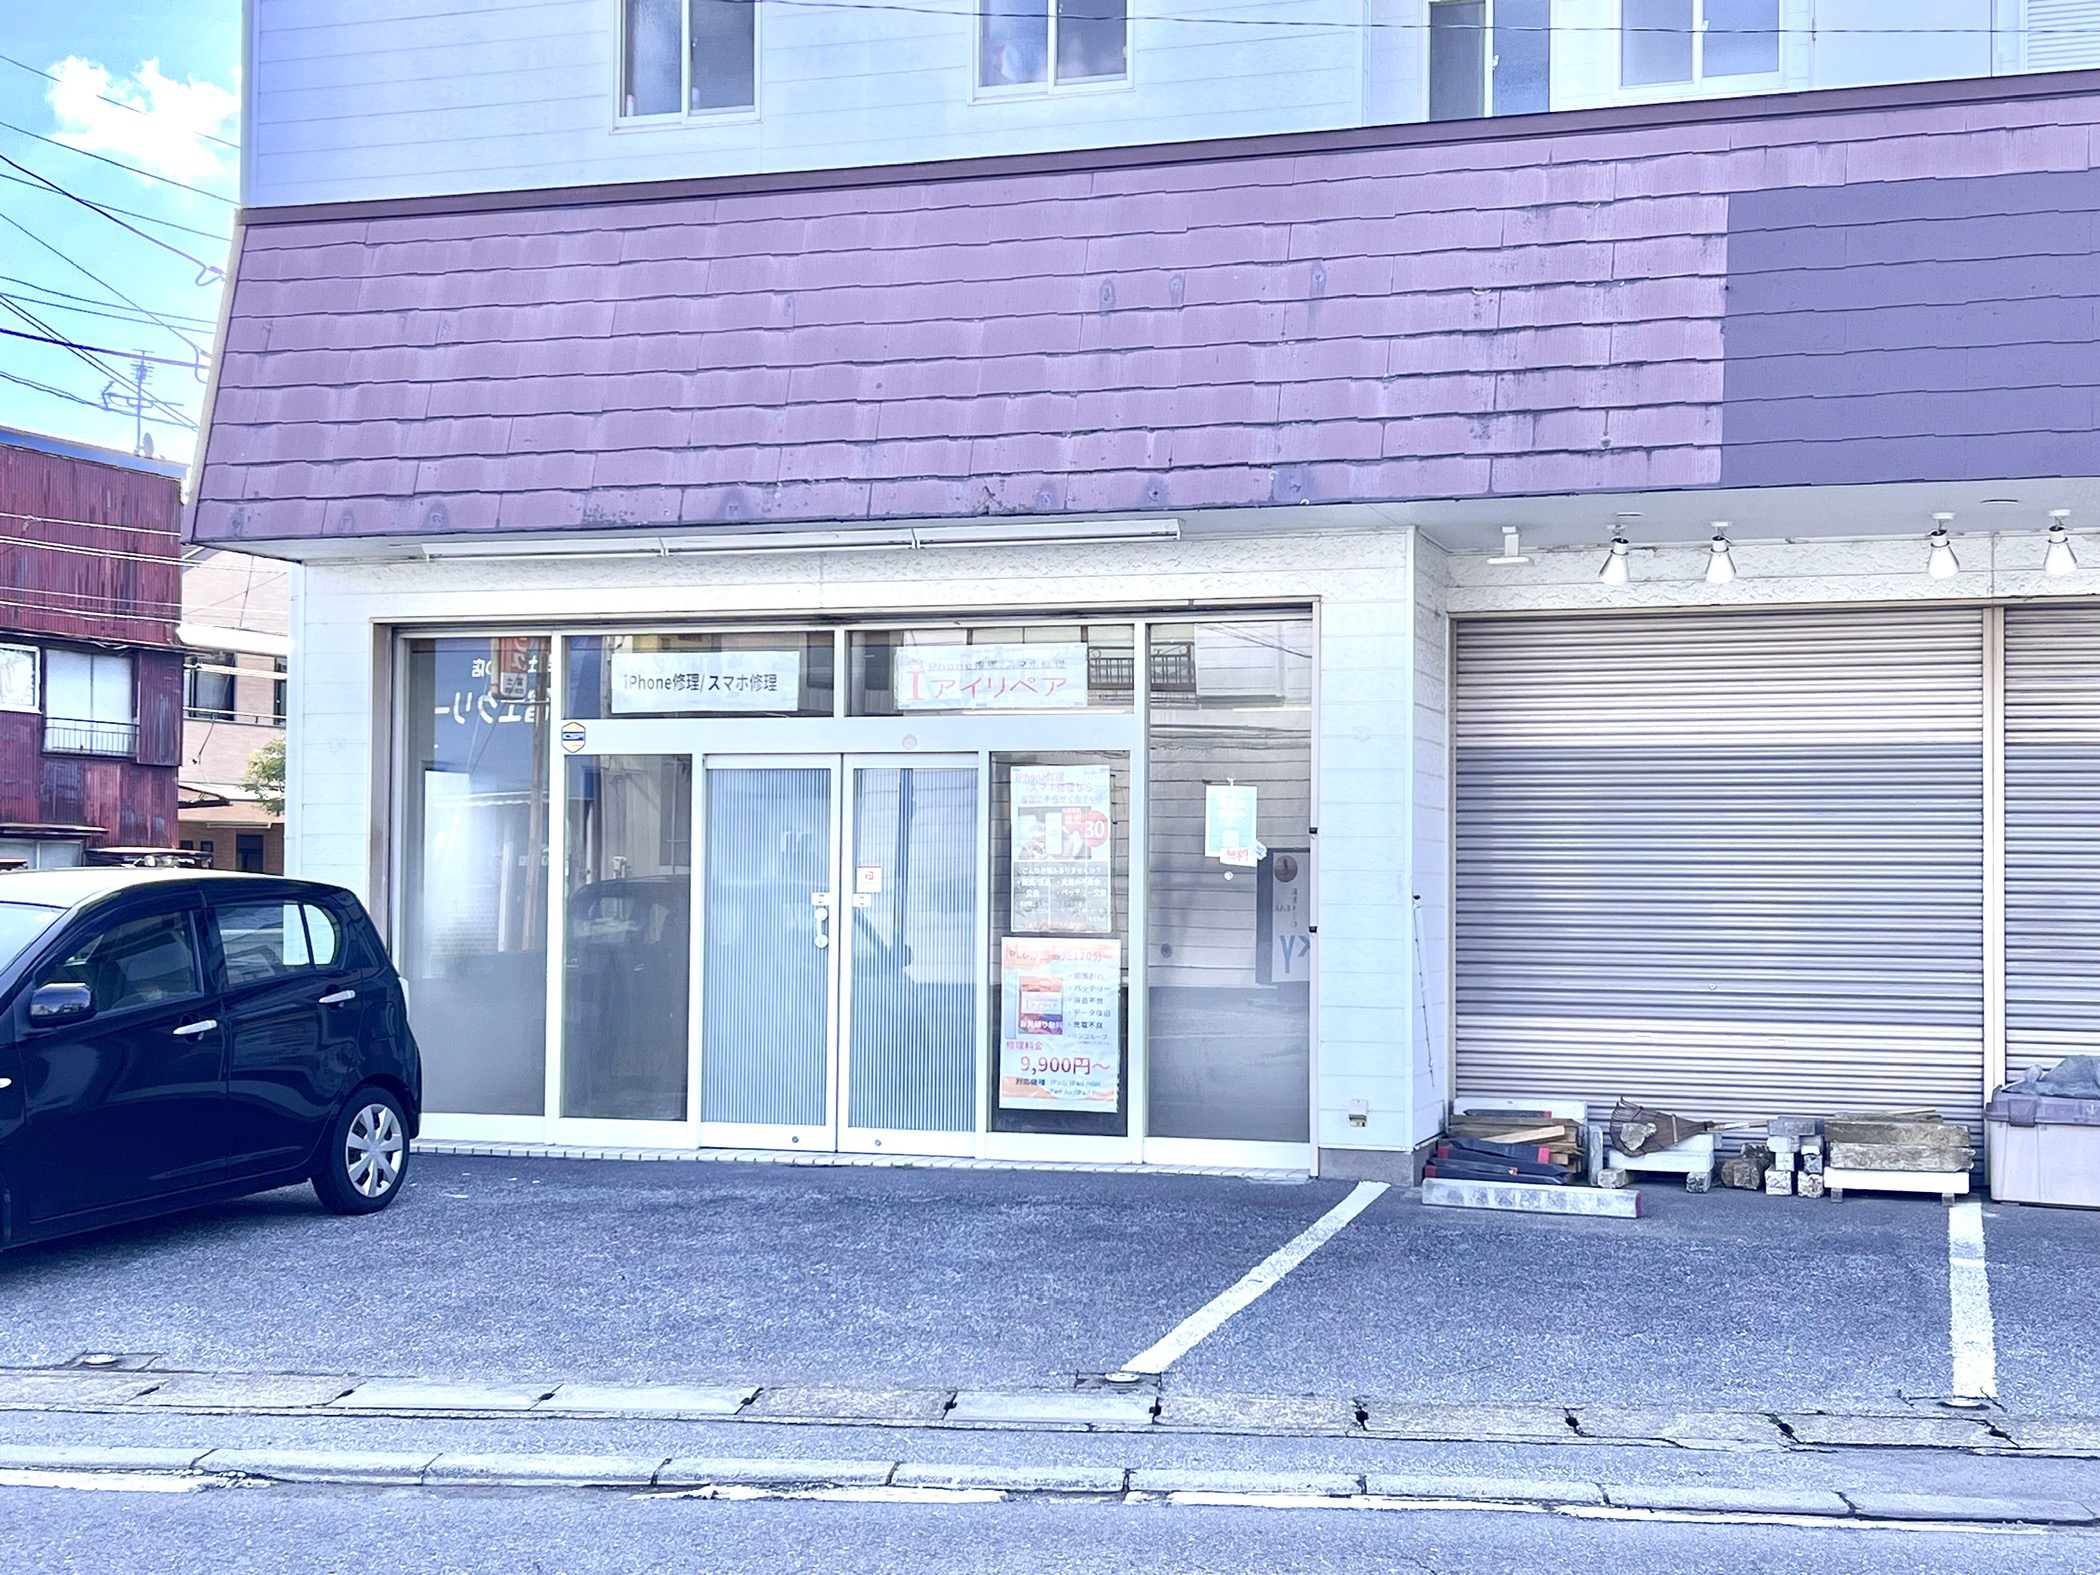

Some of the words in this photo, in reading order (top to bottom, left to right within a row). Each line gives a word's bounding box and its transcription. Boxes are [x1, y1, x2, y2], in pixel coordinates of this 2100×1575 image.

[624, 673, 778, 693] iPhone修理/スマホ修理
[931, 676, 1068, 699] アイリペア
[1084, 820, 1105, 839] 30
[1020, 1056, 1110, 1075] 9,900円〜
